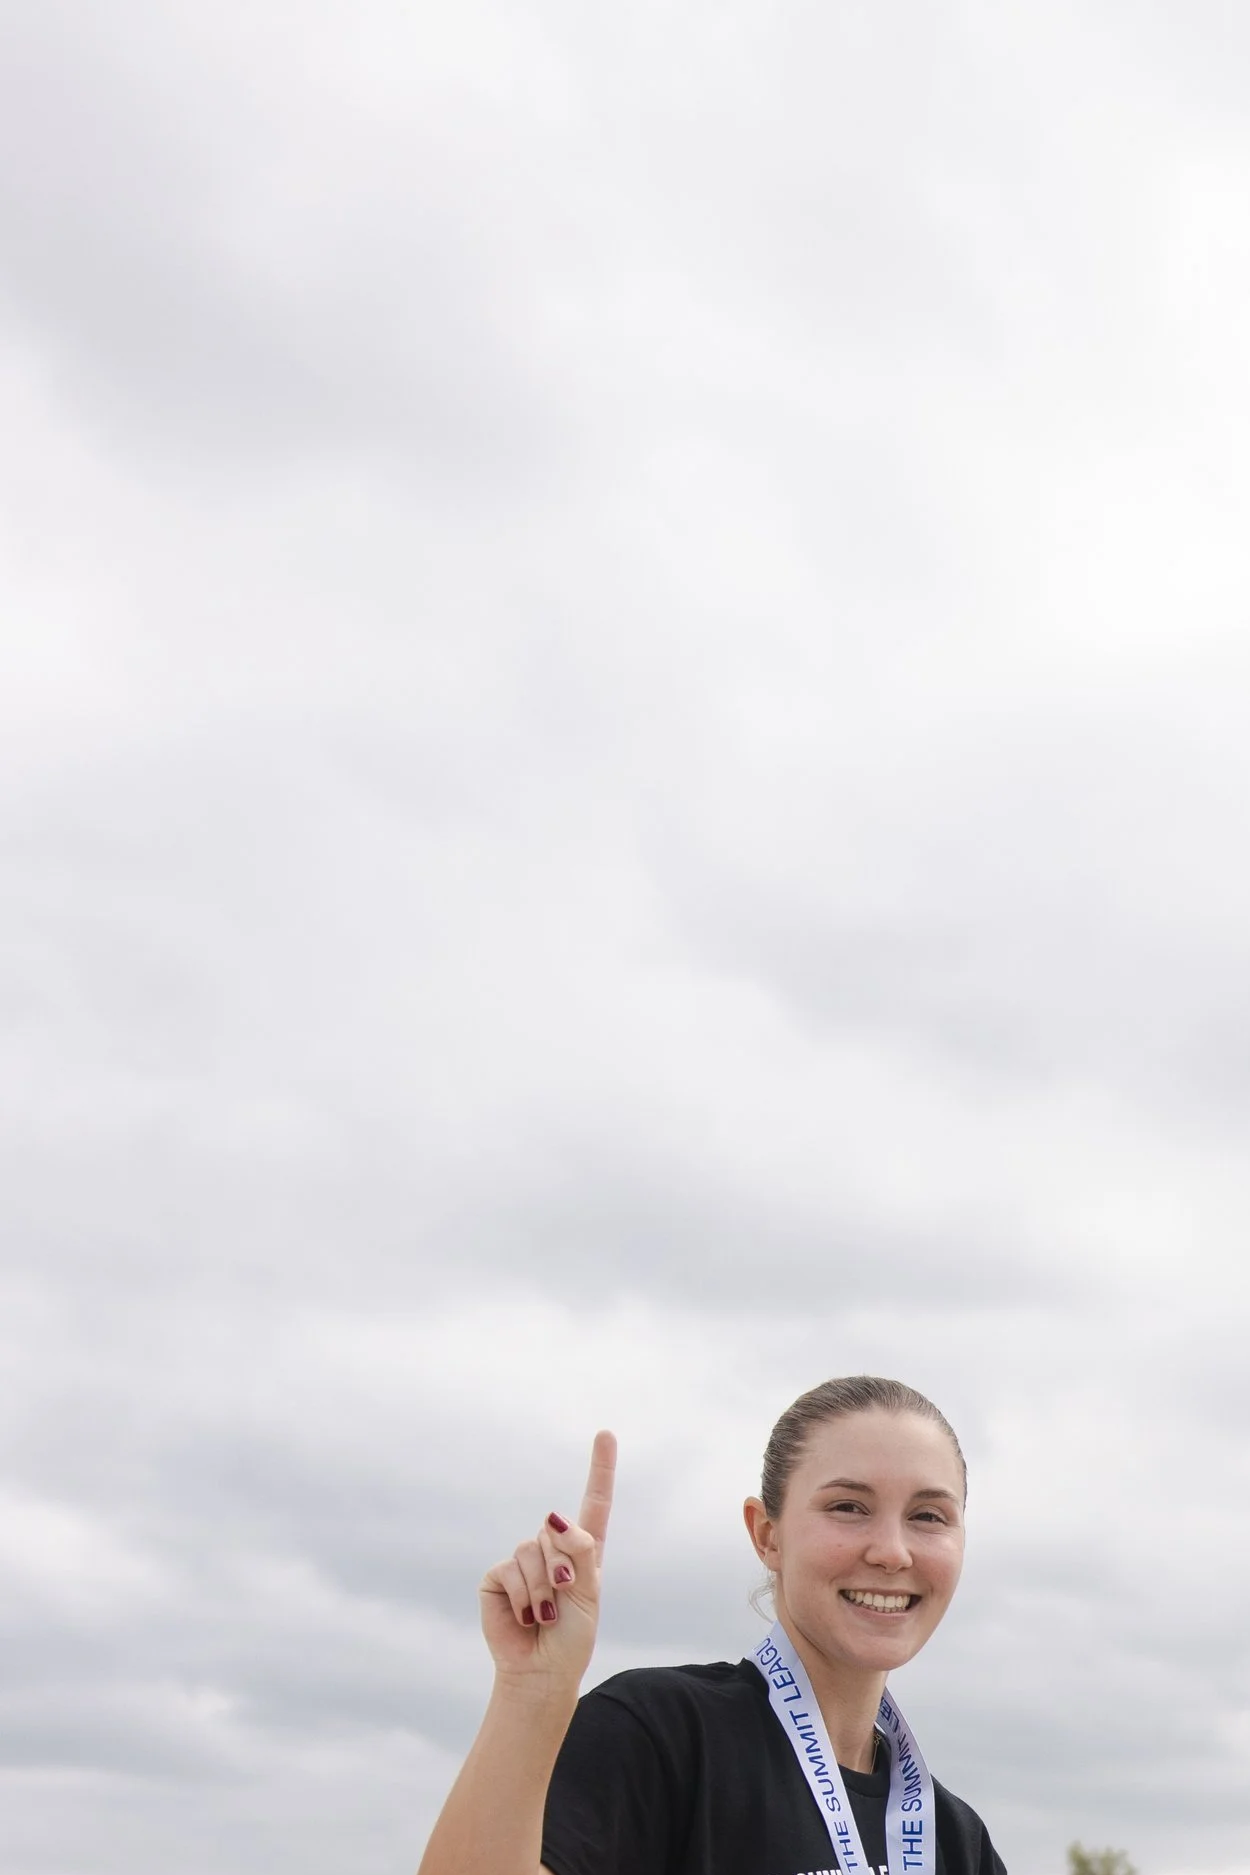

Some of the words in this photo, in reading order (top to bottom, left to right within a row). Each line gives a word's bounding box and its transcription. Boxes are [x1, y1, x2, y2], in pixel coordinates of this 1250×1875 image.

[756, 1638, 802, 1702] LEAGU
[789, 1710, 841, 1812] SUMMIT
[898, 1733, 922, 1812] SUMMIT
[836, 1820, 858, 1873] THE
[903, 1820, 922, 1871] THE
